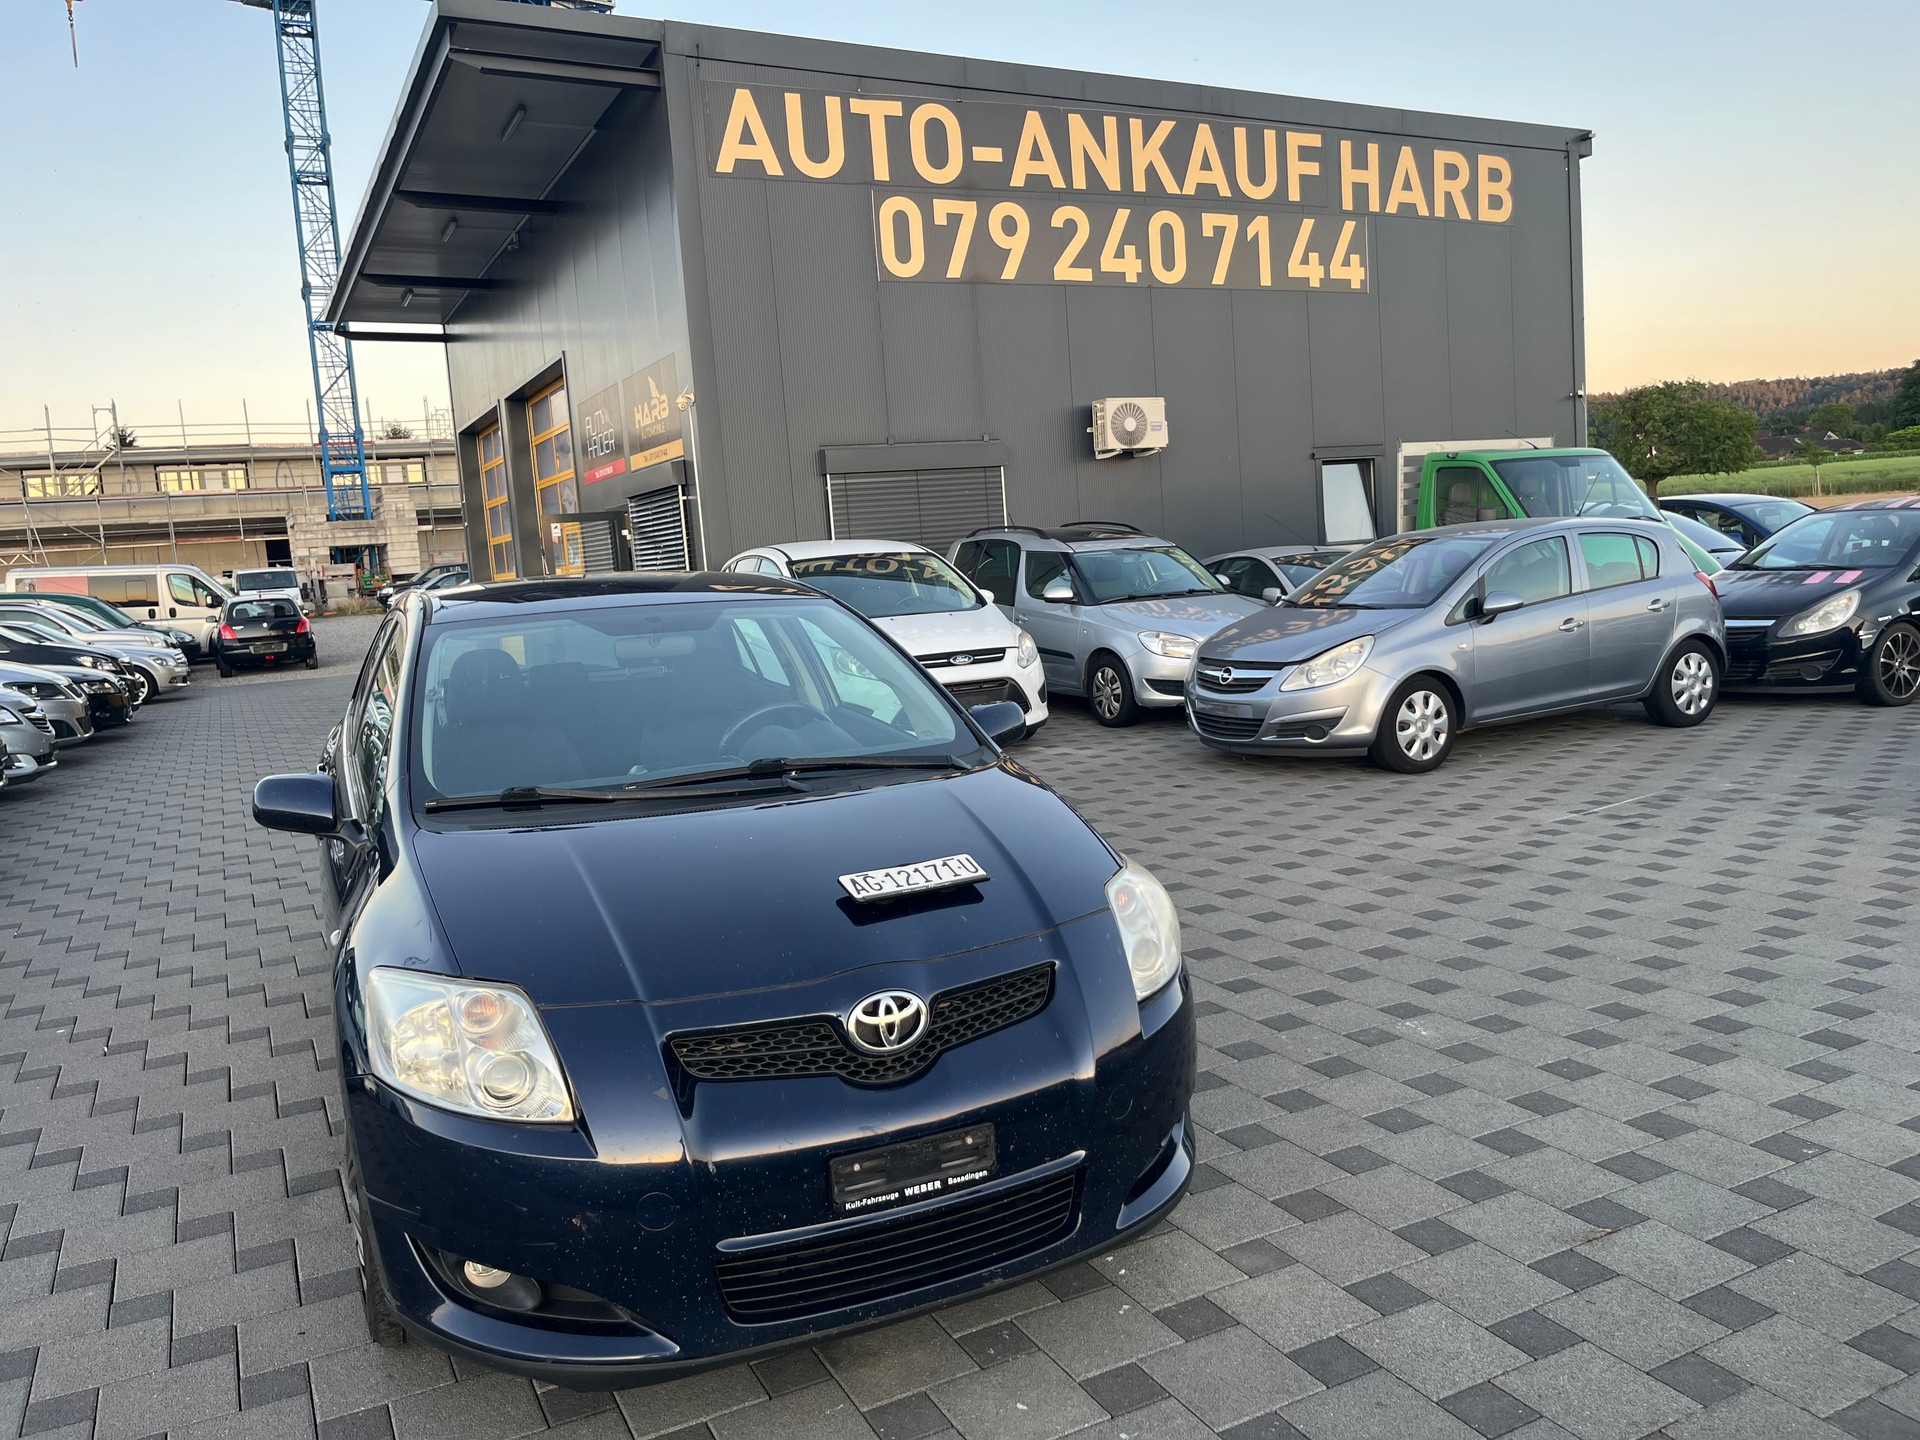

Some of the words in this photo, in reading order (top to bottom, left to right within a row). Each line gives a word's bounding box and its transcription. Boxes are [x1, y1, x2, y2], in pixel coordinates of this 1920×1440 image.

[716, 88, 1322, 202] AUTO-ANKAUF
[1340, 140, 1514, 223] HARB
[879, 196, 1031, 281] 079
[1051, 205, 1187, 286] 240
[1202, 213, 1272, 287] 71
[1287, 218, 1366, 290] 44
[634, 393, 670, 429] HARB
[845, 1191, 899, 1210] Kult-Fahrzeuge
[904, 1179, 942, 1197] WEBER
[947, 1169, 988, 1185] Basadingen
